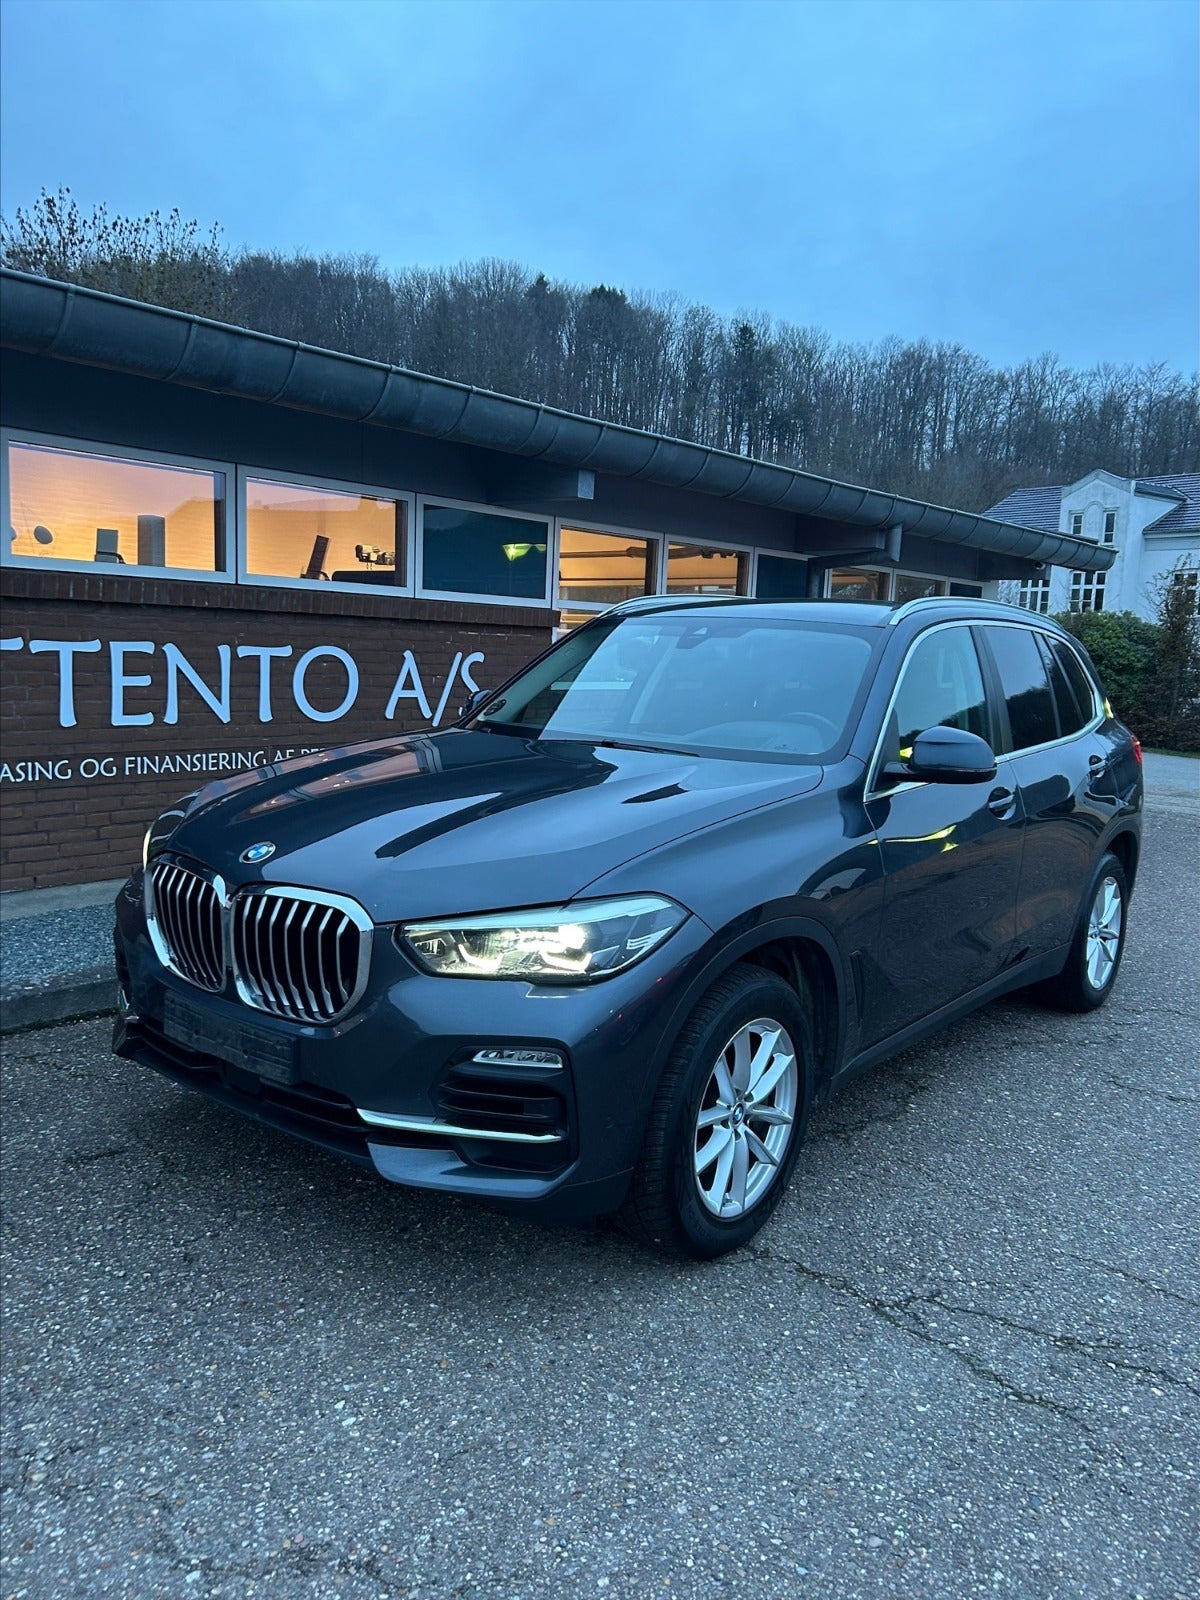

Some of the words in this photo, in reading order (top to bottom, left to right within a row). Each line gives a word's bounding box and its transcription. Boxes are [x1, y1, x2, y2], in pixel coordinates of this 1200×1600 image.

[385, 650, 485, 727] A/S
[0, 760, 72, 782] ASING
[79, 757, 118, 778] OG
[125, 751, 265, 776] FINANSIERING
